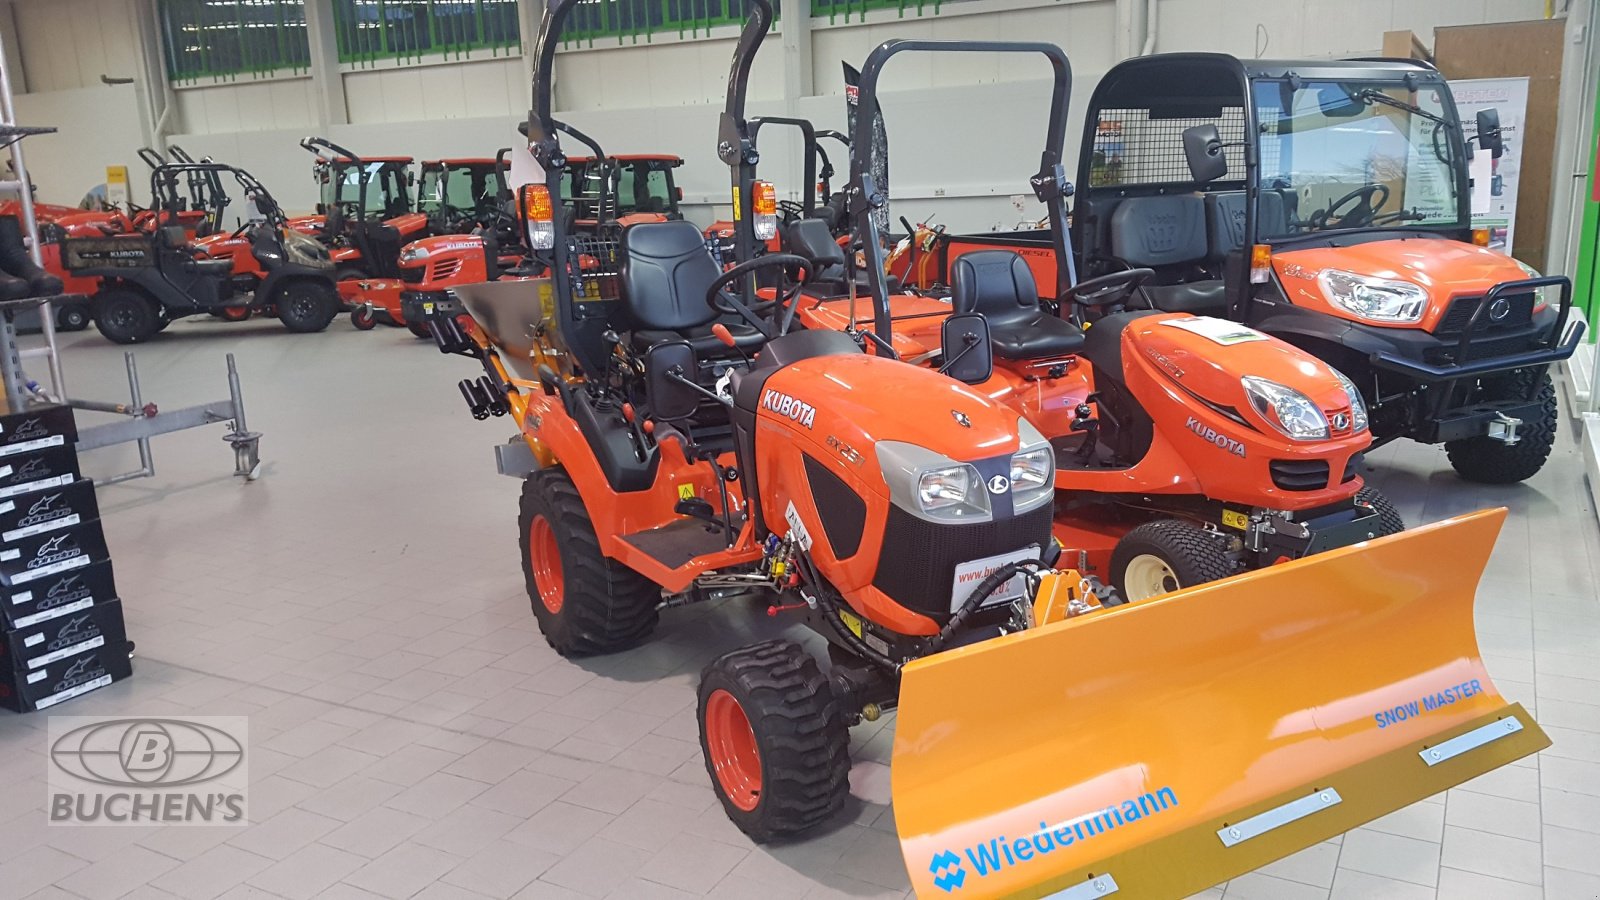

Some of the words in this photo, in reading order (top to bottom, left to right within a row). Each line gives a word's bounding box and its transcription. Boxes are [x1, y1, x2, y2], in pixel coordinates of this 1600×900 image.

[110, 250, 144, 258] KUBOTA
[1018, 249, 1054, 258] DIESEL
[763, 389, 817, 430] KUBOTA
[1185, 416, 1247, 458] KUBOTA
[1375, 706, 1420, 728] SNOW
[1422, 679, 1483, 711] MASTER
[965, 787, 1179, 876] Wiedenmann
